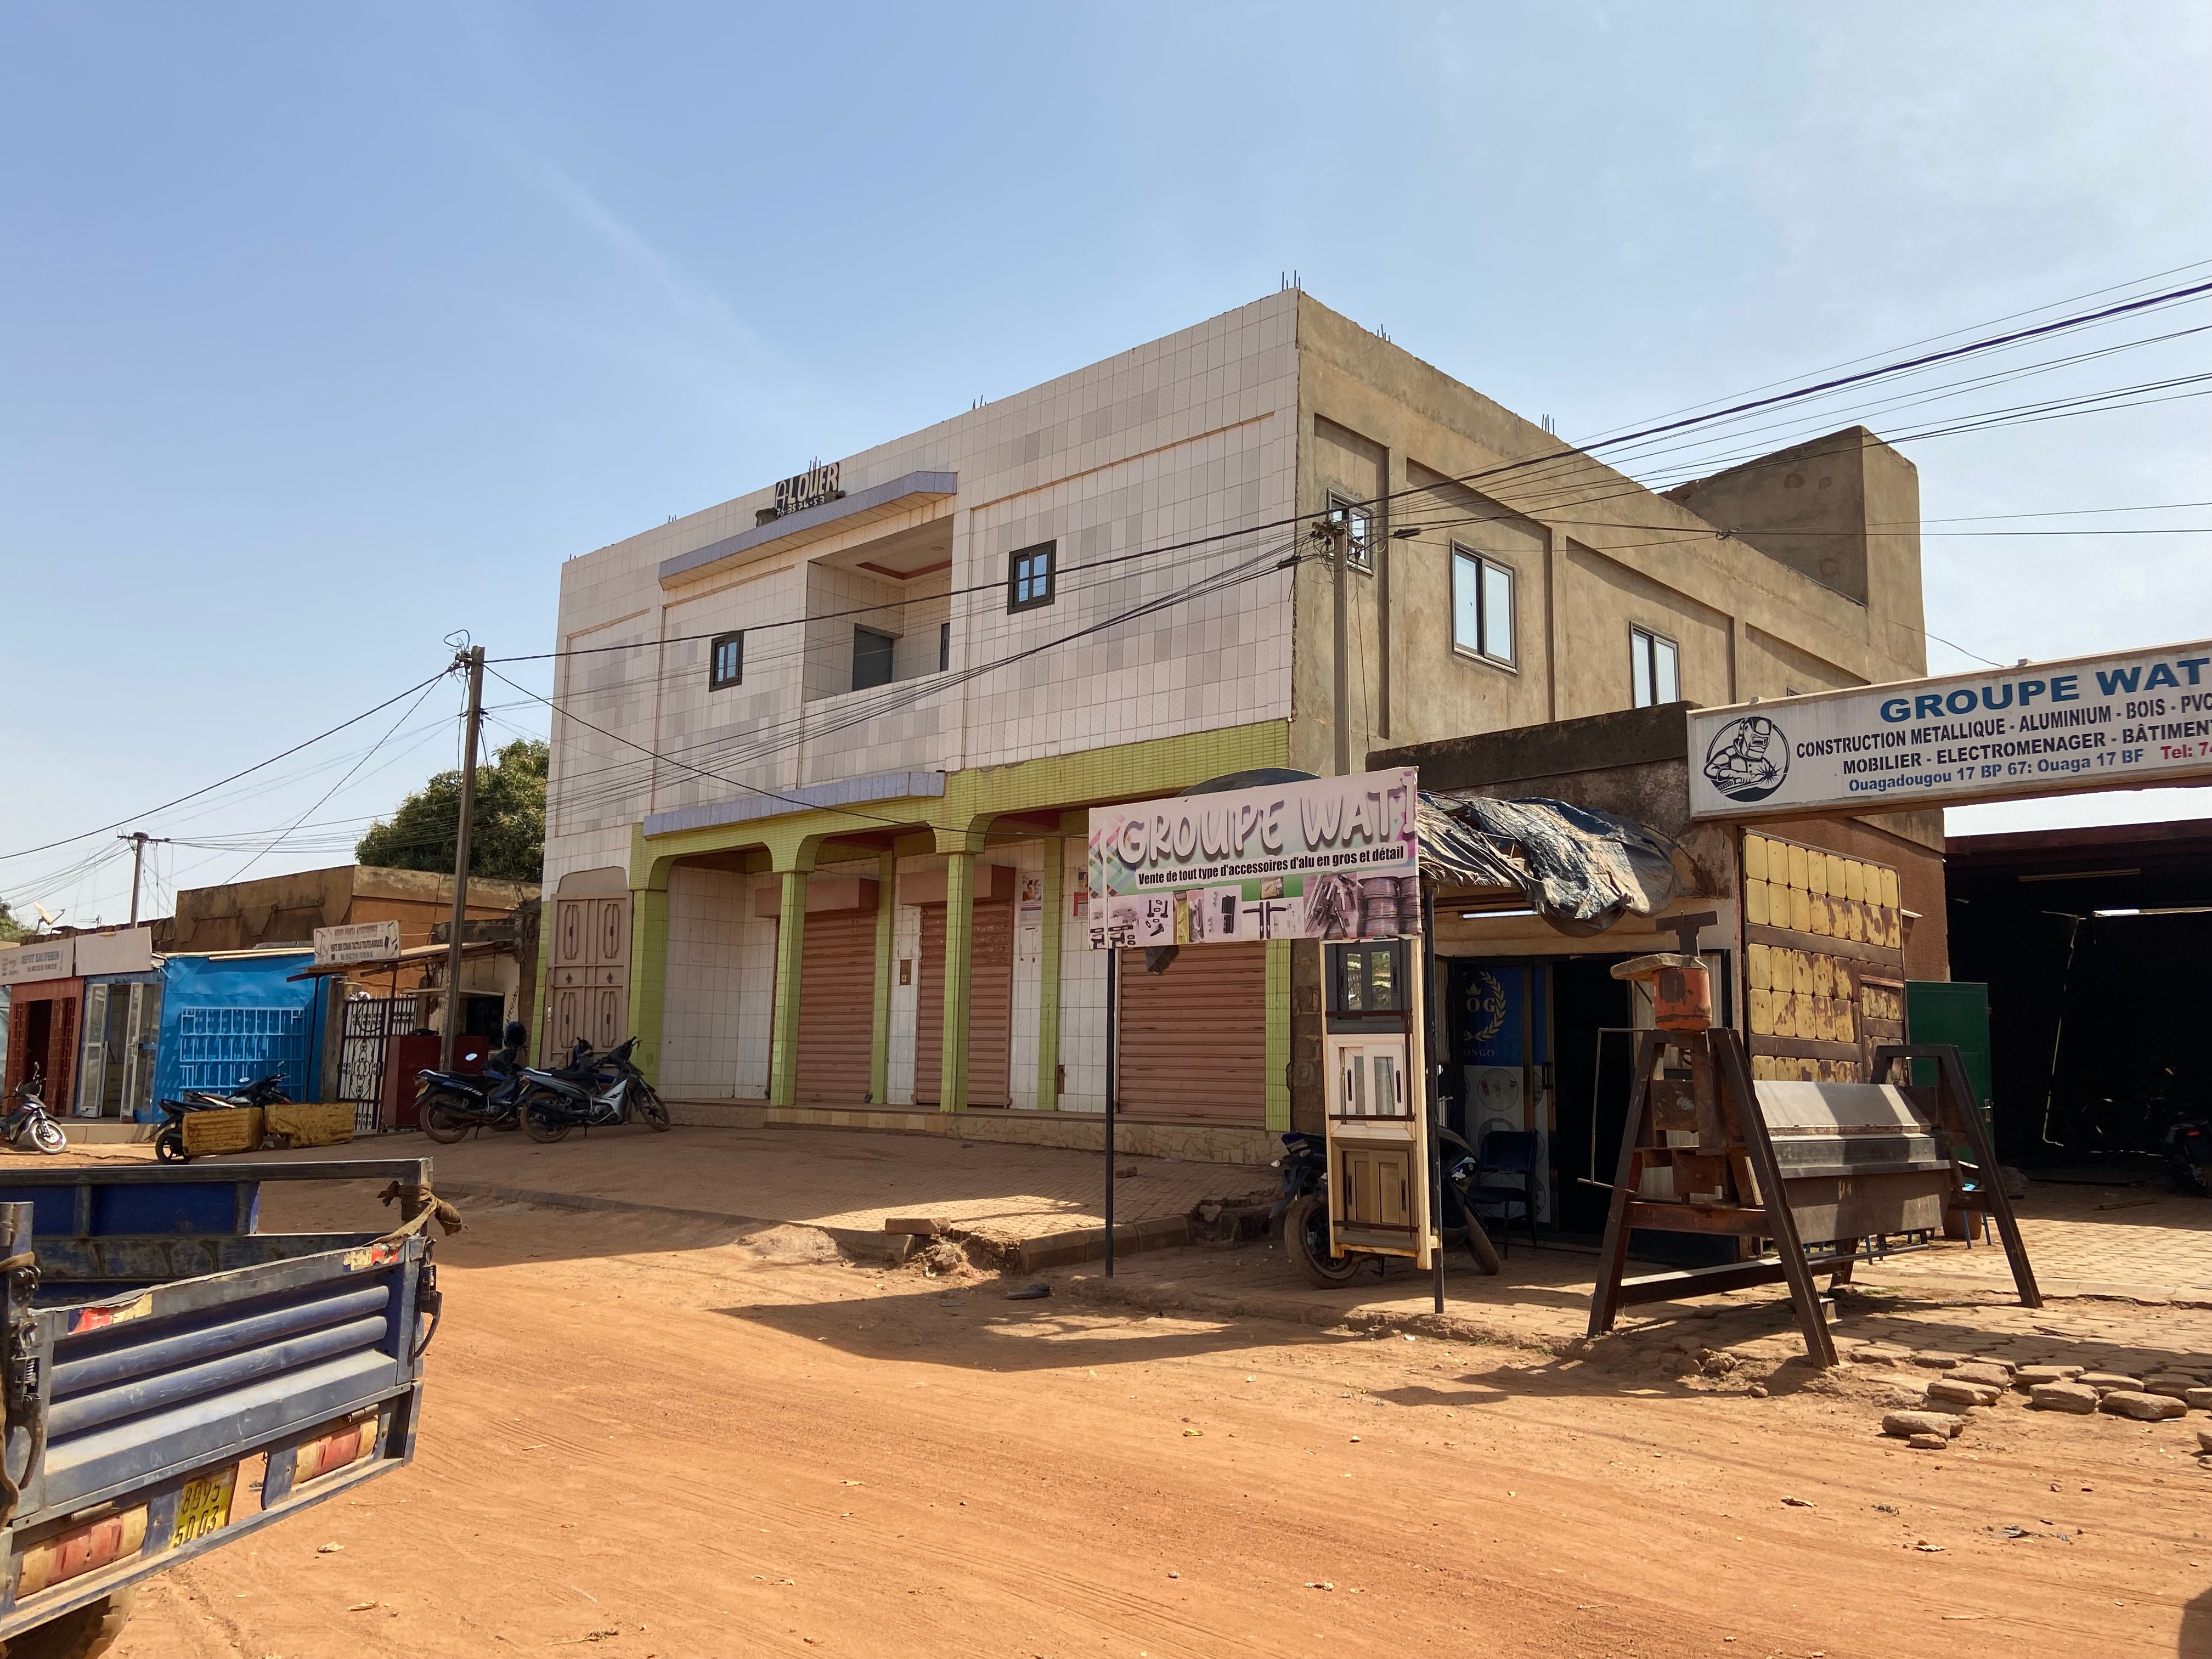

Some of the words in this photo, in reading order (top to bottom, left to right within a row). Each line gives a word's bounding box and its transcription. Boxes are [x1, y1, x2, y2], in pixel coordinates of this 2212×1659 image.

[1880, 675, 2080, 723] GROUPE
[2095, 658, 2210, 696] WAT
[1797, 730, 1905, 759] CONSTRUCTION
[1911, 718, 2006, 745] METALLIQUE
[2019, 705, 2112, 732] ALUMINIUM
[2126, 698, 2165, 719] BOIS
[2181, 692, 2212, 713] PVC
[1843, 753, 1922, 775] MOBILIER
[1937, 732, 2106, 764] ELECTROMENAGER
[2123, 719, 2212, 744] BÂTIMEN
[1849, 772, 1952, 792] Ouagadougou
[1957, 766, 1975, 781] 17
[1981, 764, 2001, 778] BP
[2007, 761, 2032, 776] 67:
[2038, 757, 2091, 772] Ouaga
[2097, 752, 2116, 766] 17
[2122, 748, 2144, 764] BF
[2160, 744, 2193, 760] Tel:
[2198, 742, 2212, 756] 7
[1117, 795, 1285, 864] GROUPE
[1138, 872, 1164, 885] Vente
[1166, 871, 1178, 883] de
[1179, 869, 1197, 882] tout
[1198, 868, 1218, 880] type
[1220, 860, 1288, 876] d'accessoires
[1290, 856, 1314, 870] d'alu
[1317, 855, 1330, 867] en
[1333, 853, 1357, 865] gros
[1359, 850, 1370, 862] et
[1372, 846, 1404, 861] détail
